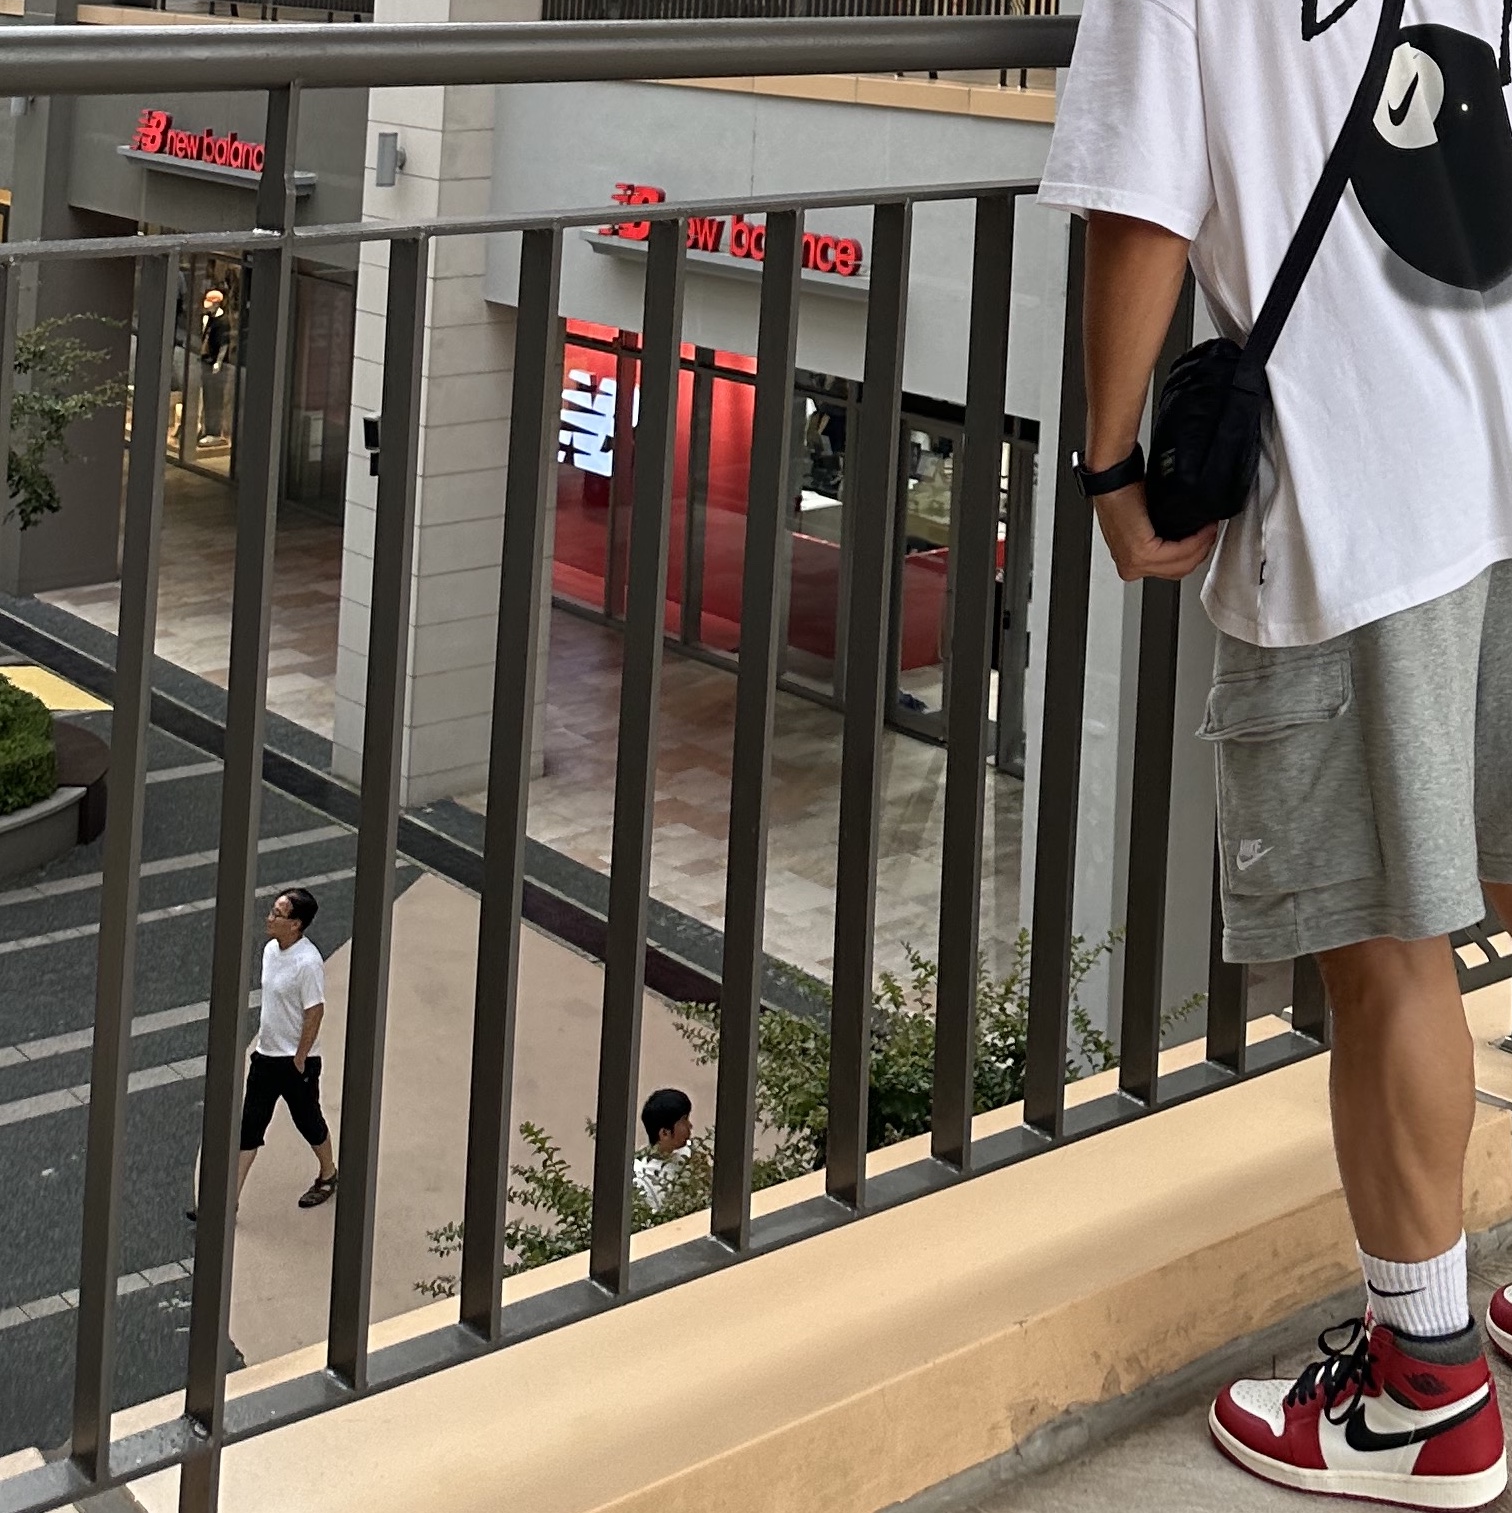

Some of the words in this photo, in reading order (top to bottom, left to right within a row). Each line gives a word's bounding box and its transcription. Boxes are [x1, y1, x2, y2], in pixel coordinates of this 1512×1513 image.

[168, 129, 200, 160] new
[203, 128, 265, 172] balanc
[729, 213, 862, 276] bance
